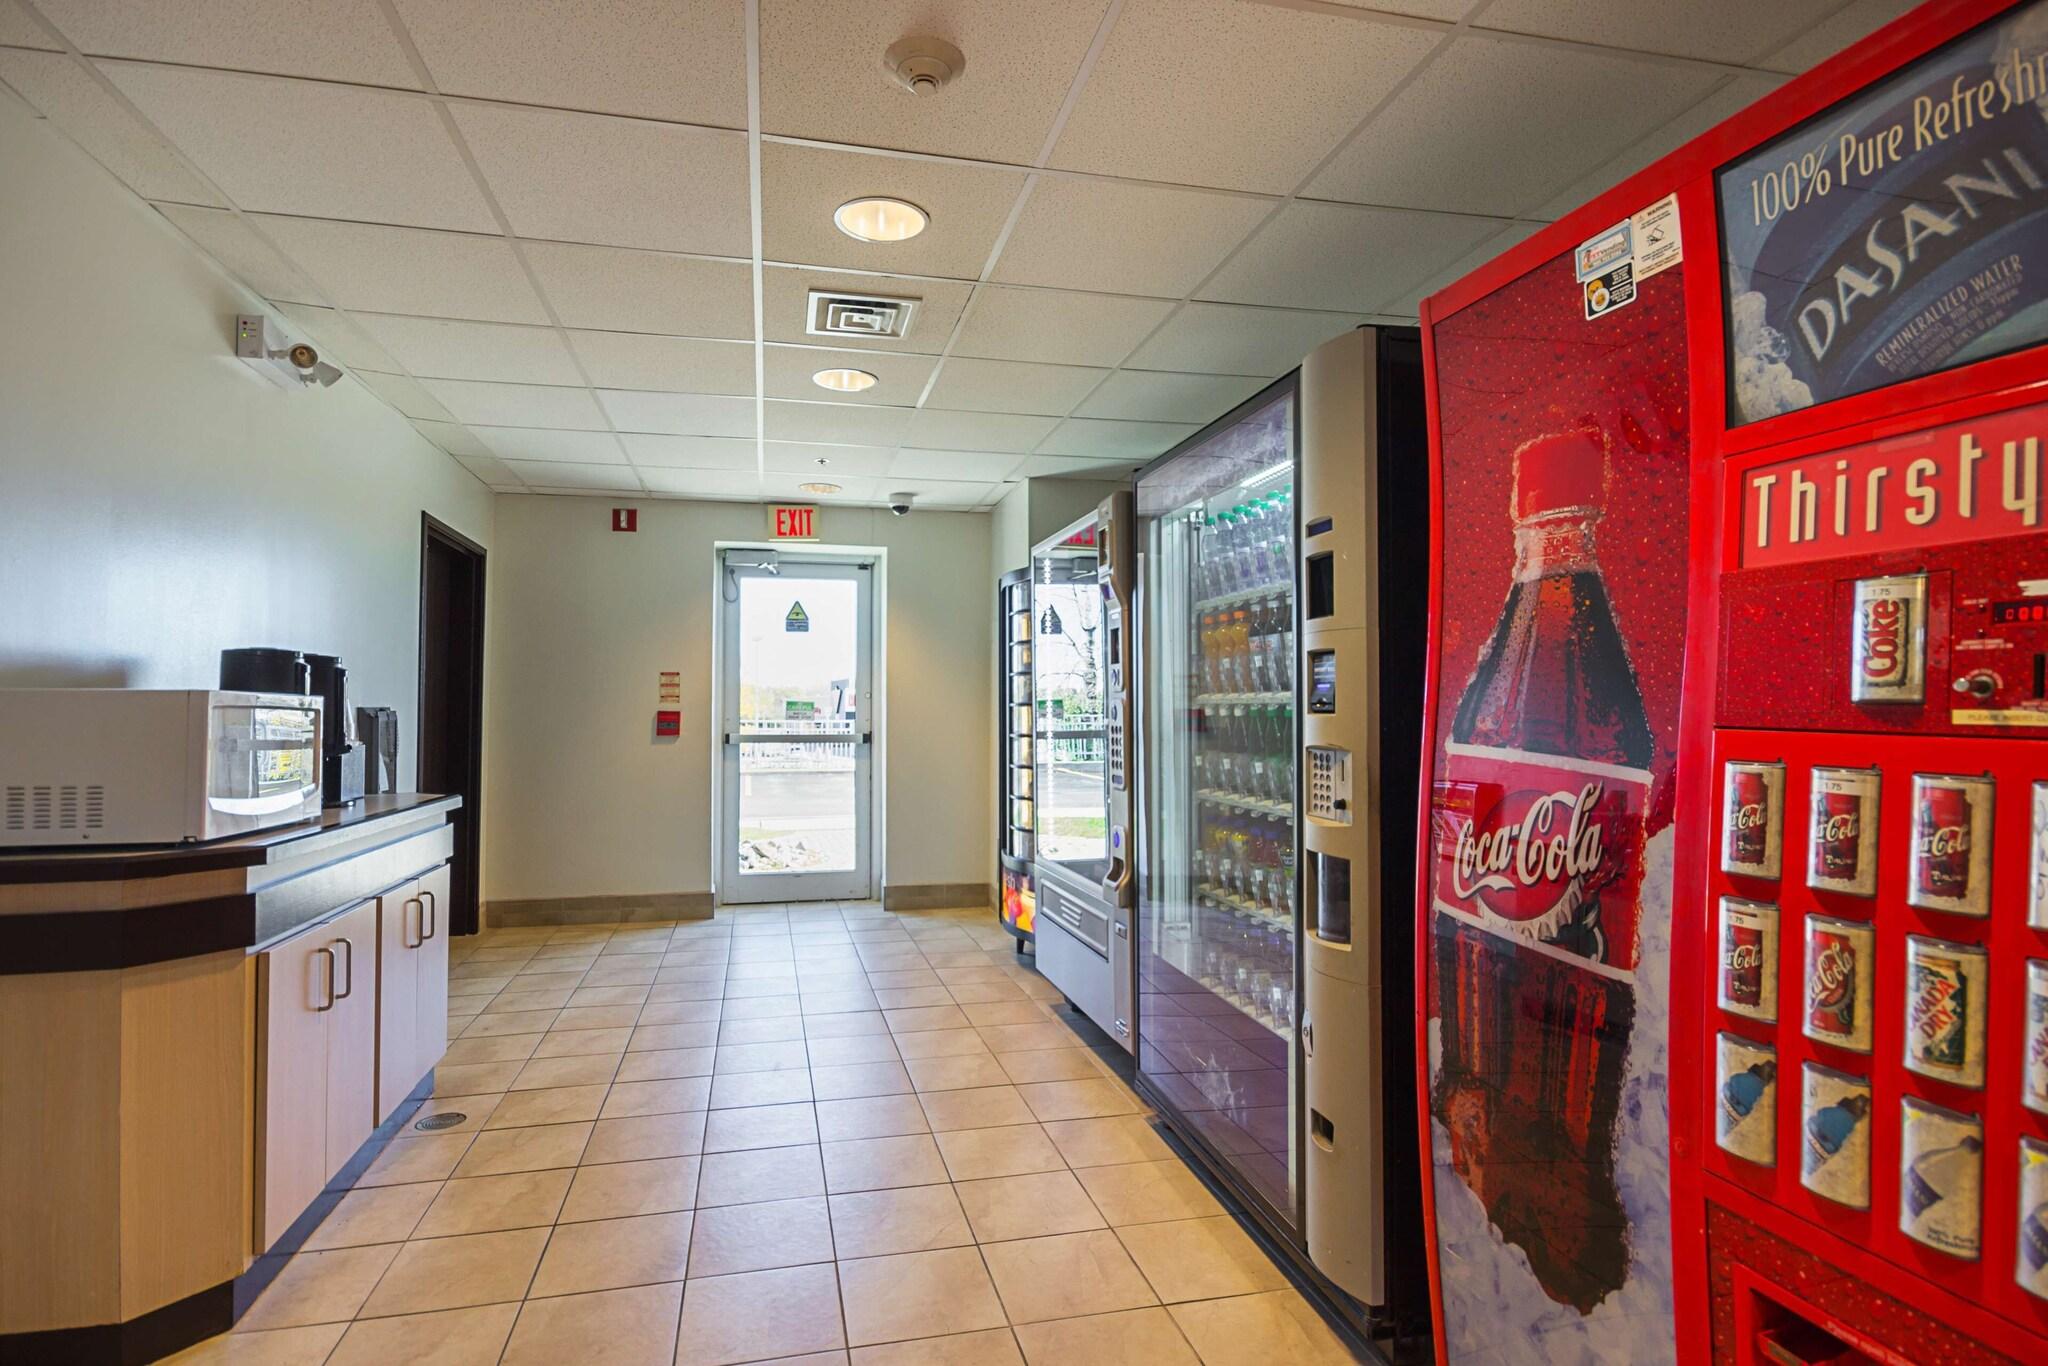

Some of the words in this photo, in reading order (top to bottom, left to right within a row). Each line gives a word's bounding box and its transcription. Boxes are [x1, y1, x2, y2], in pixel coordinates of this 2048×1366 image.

[1751, 143, 1832, 227] 100%
[1839, 124, 1904, 187] Pure
[1797, 147, 2044, 362] DASANI
[1874, 286, 1969, 368] REMINERALIZED
[1969, 253, 2024, 292] WATER
[776, 508, 814, 538] EXIT
[1752, 433, 2039, 549] Thirsty
[1862, 598, 1901, 678] Coke
[1453, 780, 1604, 899] Coca-Cola
[1919, 1005, 1957, 1040] DRY
